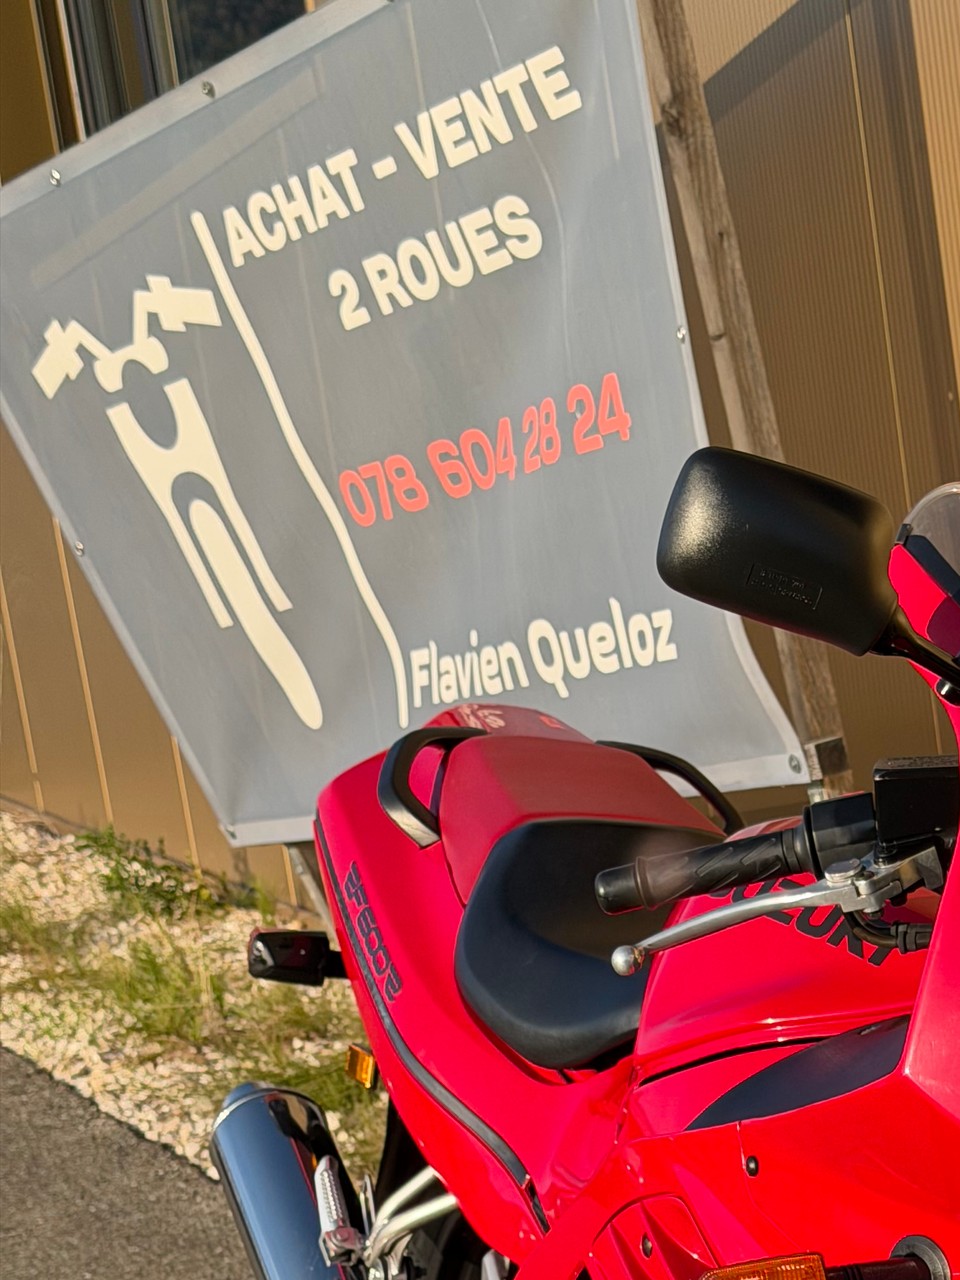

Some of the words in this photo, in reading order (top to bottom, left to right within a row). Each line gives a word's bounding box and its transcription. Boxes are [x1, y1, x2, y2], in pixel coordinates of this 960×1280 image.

[222, 148, 365, 268] ACHAT
[394, 46, 582, 180] VENTE
[328, 268, 371, 331] 2
[361, 195, 543, 316] ROUES
[338, 454, 429, 527] 078
[566, 371, 632, 455] 24
[410, 629, 530, 708] Flavien
[527, 597, 678, 698] Queloz
